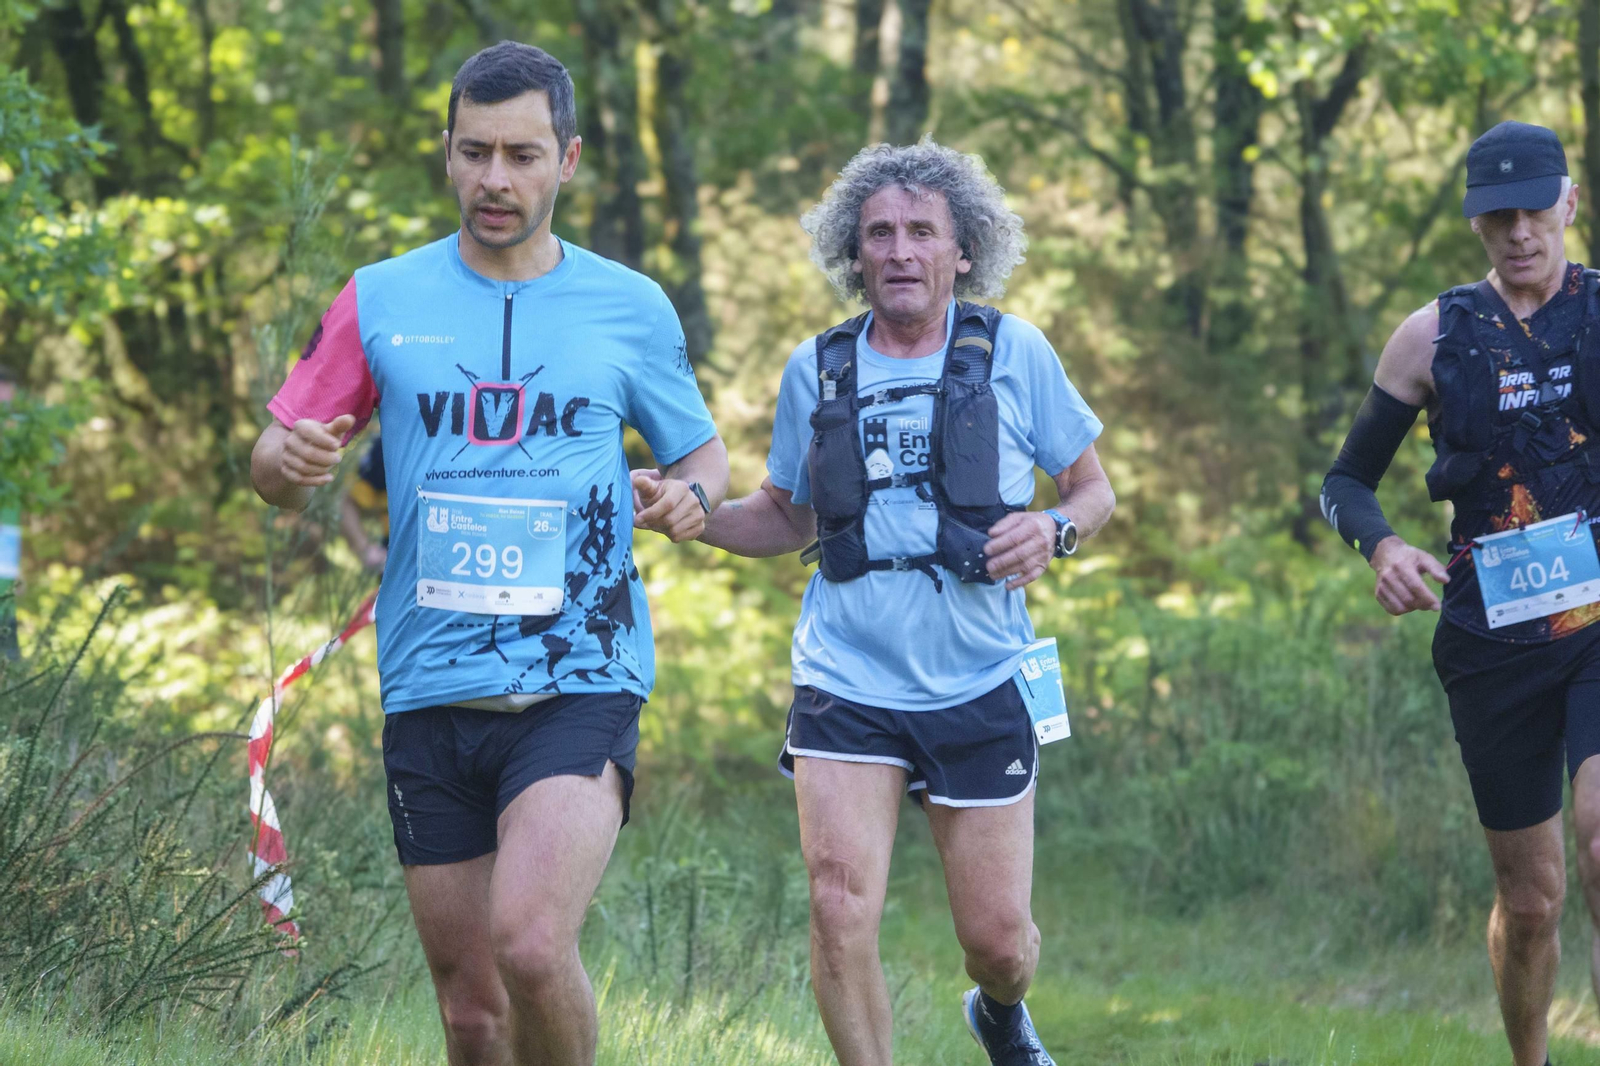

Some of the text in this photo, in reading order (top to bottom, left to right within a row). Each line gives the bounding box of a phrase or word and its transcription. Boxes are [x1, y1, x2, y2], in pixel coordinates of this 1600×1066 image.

[405, 336, 455, 345] OTTOBOSLEY
[416, 391, 590, 438] VIVAC
[899, 417, 928, 430] Trail
[425, 467, 560, 482] vivacadventure.com
[451, 513, 473, 524] Entre
[450, 521, 487, 533] Castelos
[533, 520, 549, 533] 26
[451, 541, 524, 579] 299
[1510, 556, 1570, 592] 404
